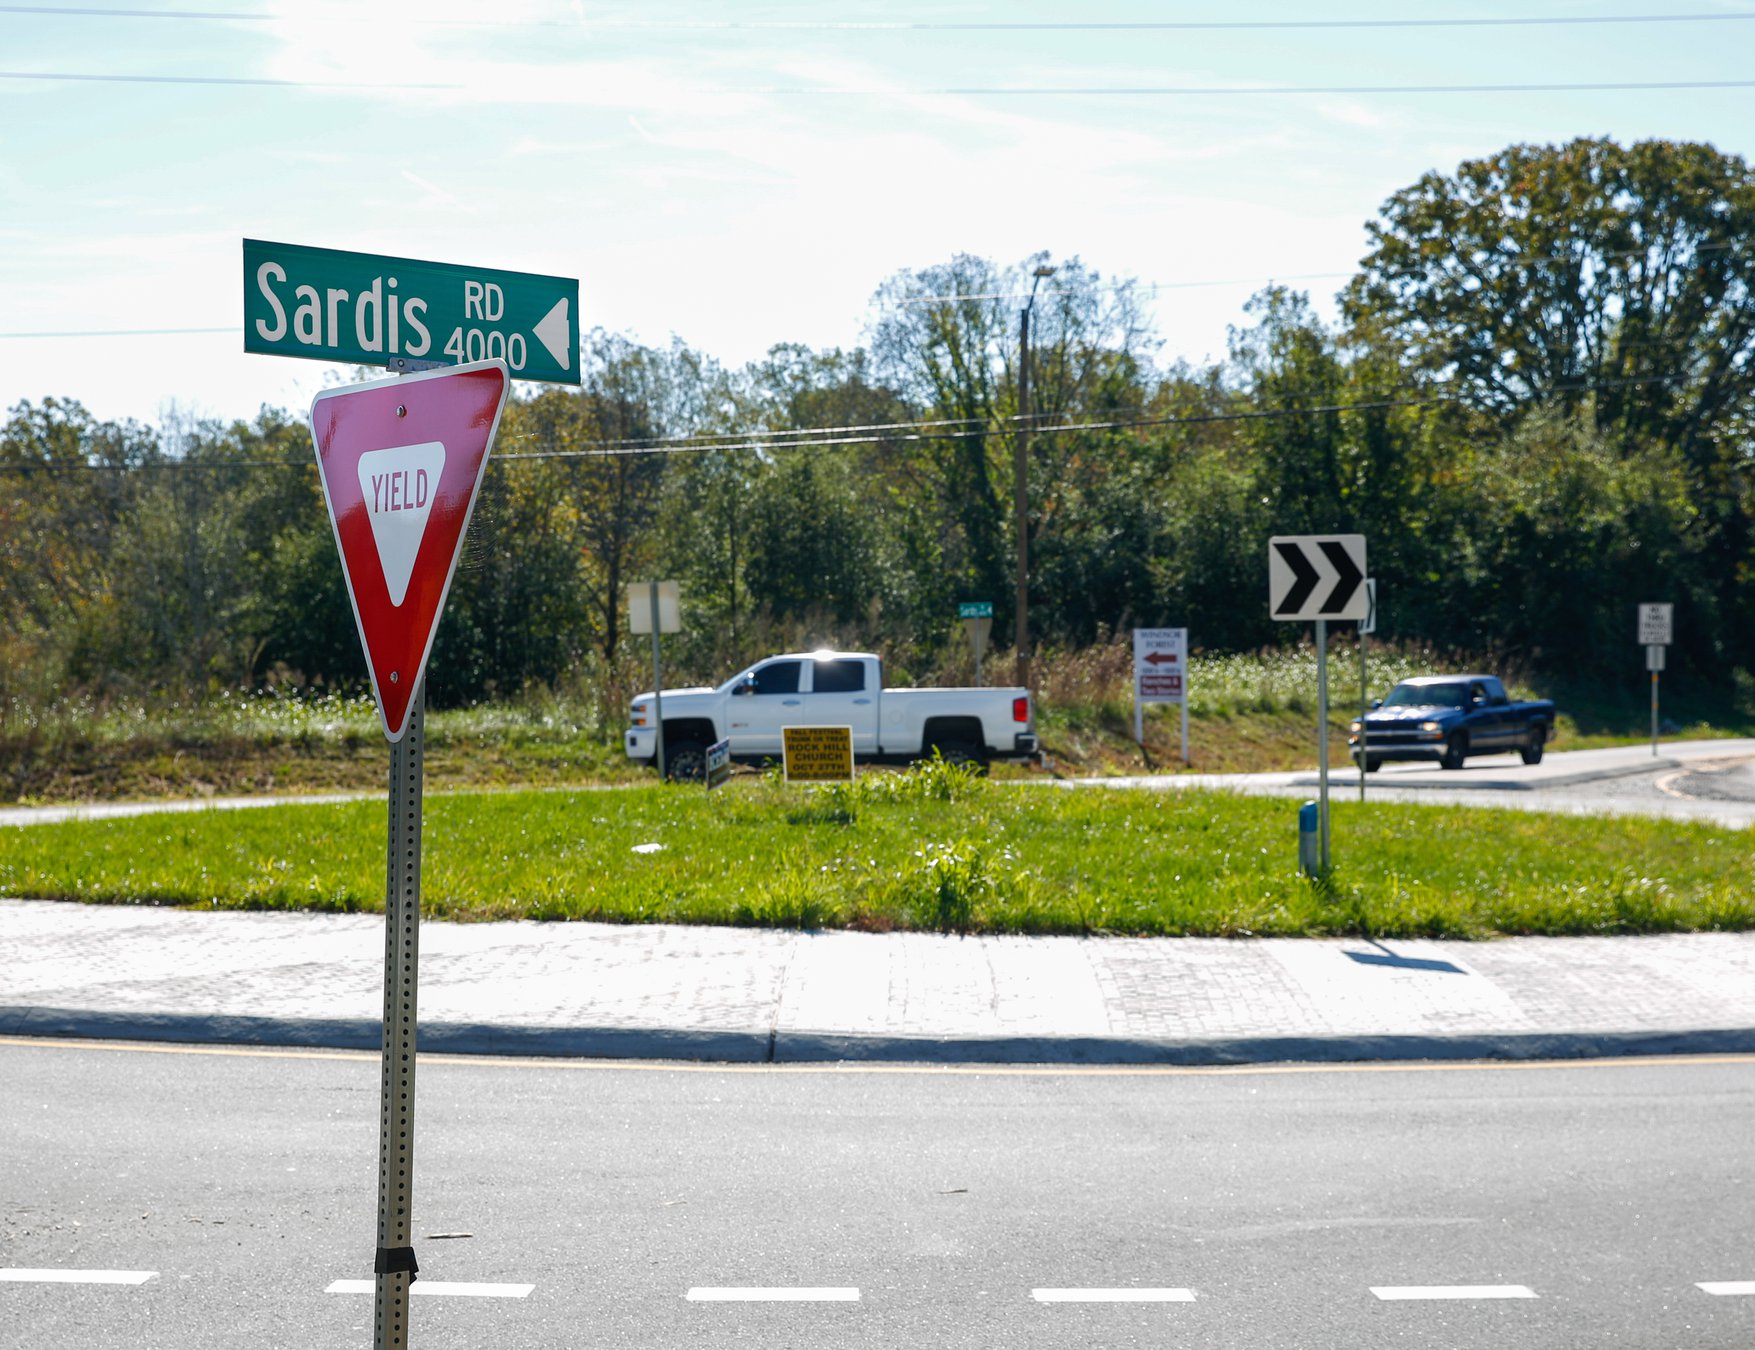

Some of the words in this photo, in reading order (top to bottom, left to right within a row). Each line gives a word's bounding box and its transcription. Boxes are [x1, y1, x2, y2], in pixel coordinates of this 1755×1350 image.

[255, 261, 432, 357] Sardis
[464, 280, 504, 322] RD
[443, 326, 527, 371] 4000
[371, 468, 428, 513] YIELD
[788, 743, 819, 751] ROCK
[823, 743, 850, 751] HILL
[792, 763, 814, 771] OCT
[794, 753, 843, 761] CHURCH
